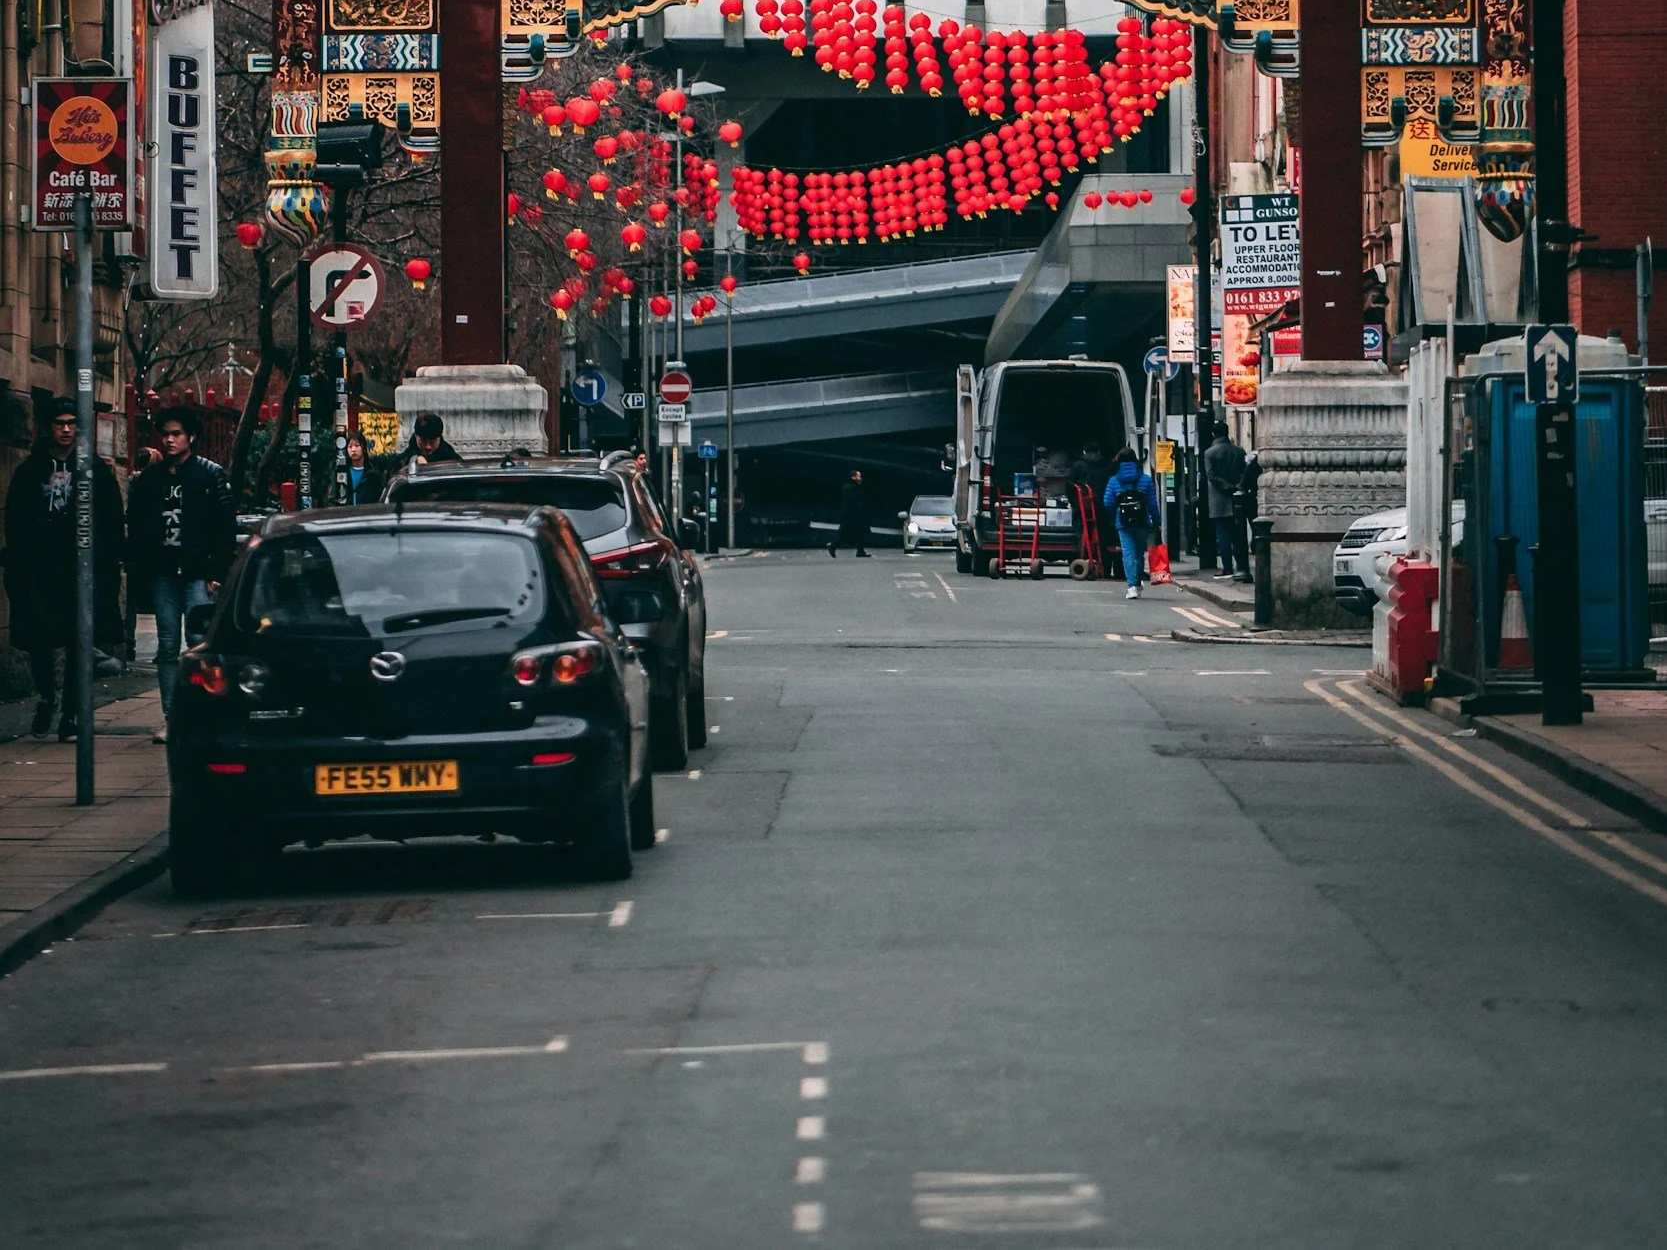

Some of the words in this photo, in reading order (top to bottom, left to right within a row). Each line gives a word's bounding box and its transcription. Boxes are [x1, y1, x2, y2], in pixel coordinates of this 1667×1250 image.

[167, 53, 201, 281] BUFFET
[1432, 158, 1478, 171] Service
[49, 169, 85, 187] Café
[90, 170, 118, 187] Bar
[1270, 197, 1291, 207] WT
[42, 211, 58, 221] Tel:
[101, 211, 123, 221] 8335
[1255, 207, 1298, 218] GUNSO
[1229, 226, 1258, 243] TO
[1265, 224, 1300, 241] LET
[1234, 244, 1266, 254] UPPER
[1236, 253, 1300, 264] RESTAURANT
[1226, 263, 1300, 274] ACCOMMODATI
[1227, 276, 1265, 285] APPROX
[1267, 274, 1300, 284] 8,000s
[1226, 292, 1254, 304] 0161
[1258, 290, 1280, 303] 833
[634, 396, 642, 405] P
[326, 764, 392, 790] FE55
